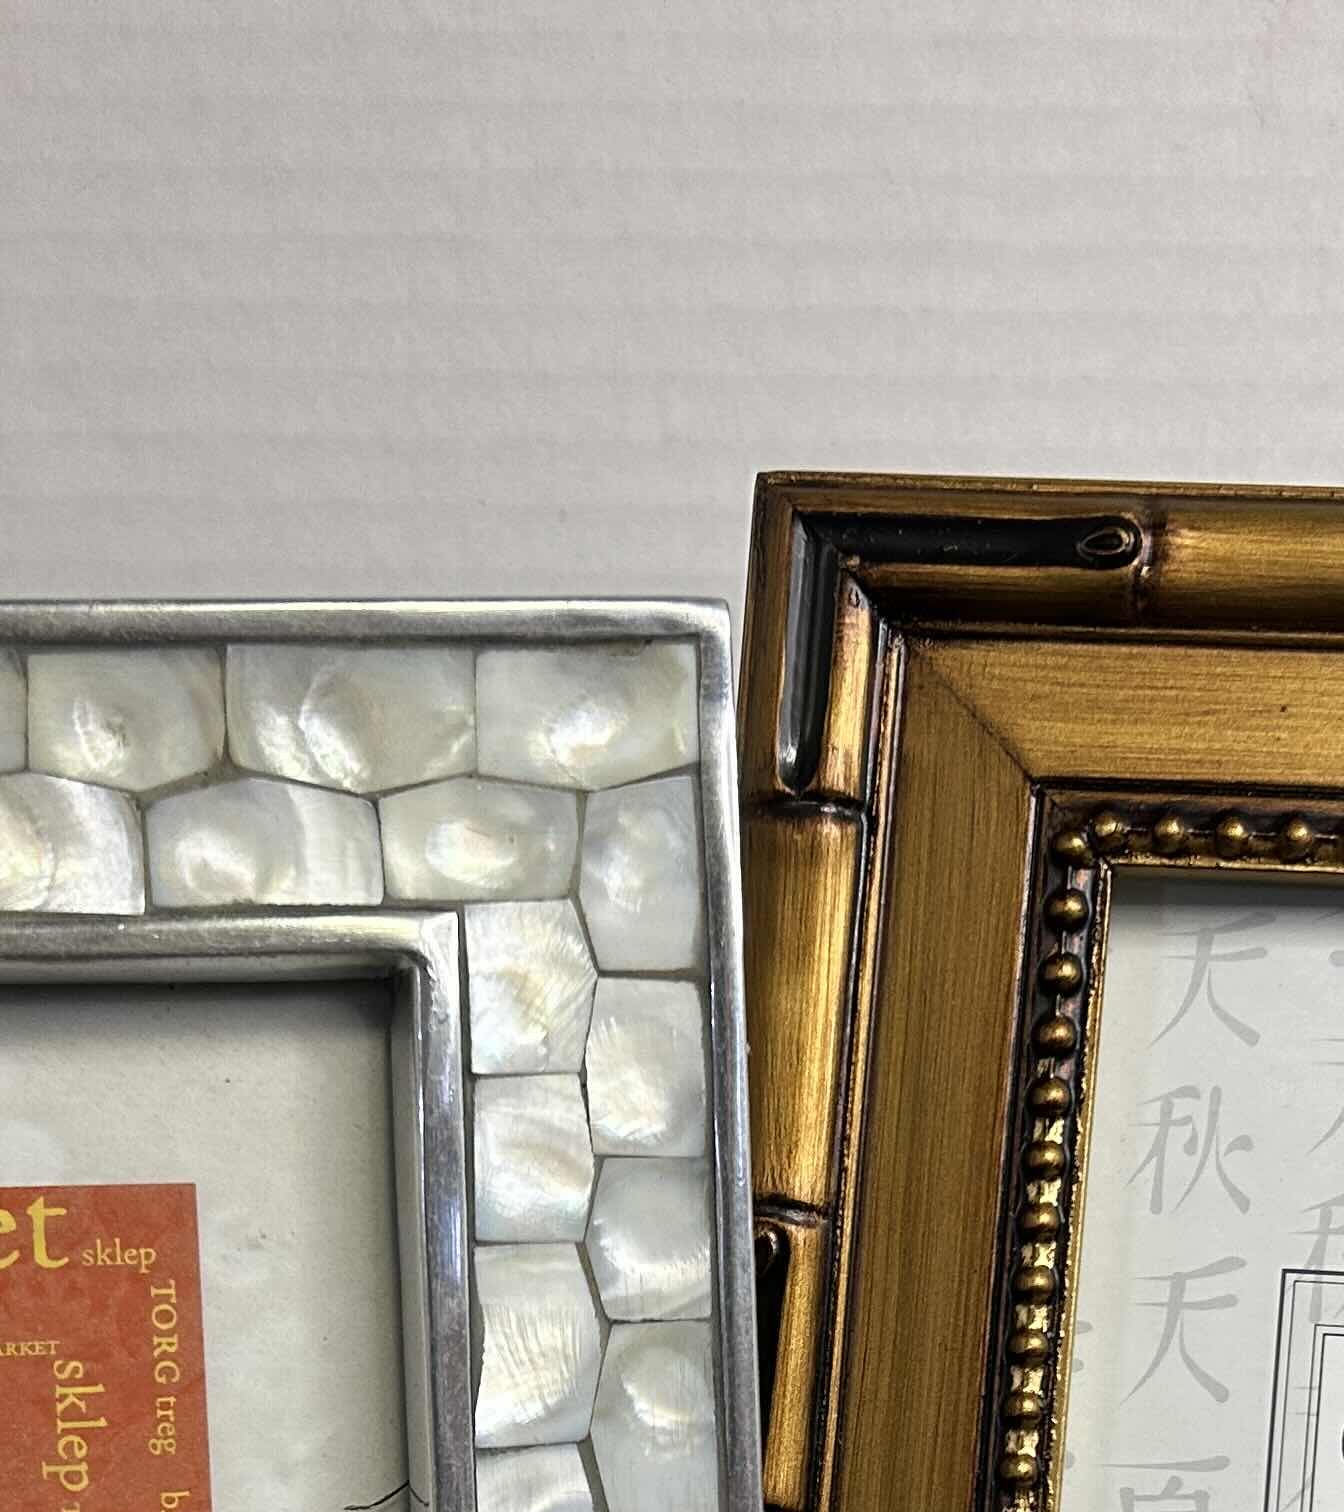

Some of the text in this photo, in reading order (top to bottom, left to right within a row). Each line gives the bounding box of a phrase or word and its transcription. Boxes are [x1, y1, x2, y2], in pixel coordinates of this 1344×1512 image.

[81, 1238, 157, 1274] sklep
[150, 1280, 181, 1385] TORG
[41, 1359, 108, 1492] sklep
[149, 1396, 177, 1456] treg
